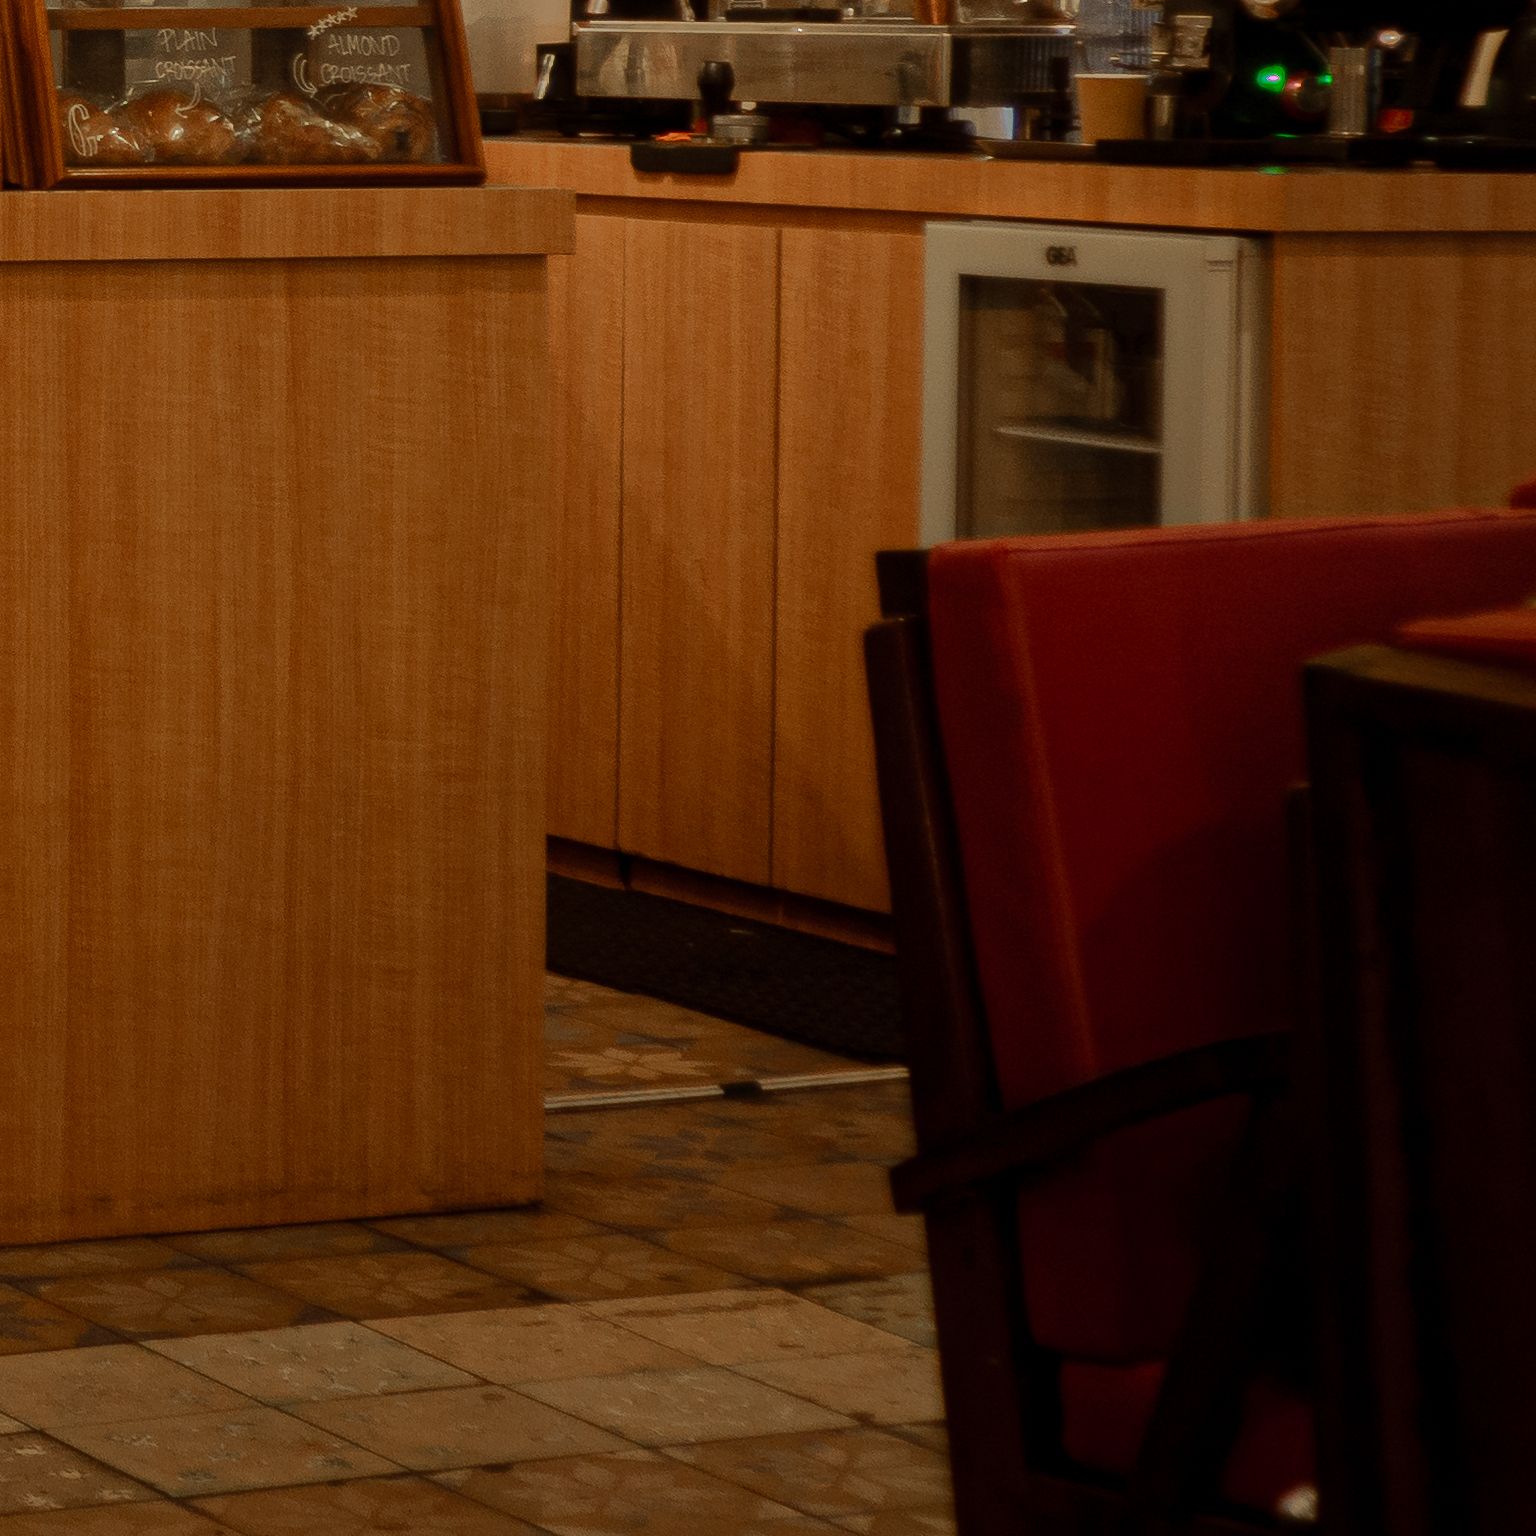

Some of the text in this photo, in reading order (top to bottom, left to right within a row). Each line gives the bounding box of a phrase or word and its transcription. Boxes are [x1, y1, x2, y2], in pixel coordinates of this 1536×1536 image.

[158, 27, 218, 53] PLAIN
[327, 33, 401, 57] ALMOND
[154, 54, 236, 81] CROISSANT
[319, 63, 411, 85] CROISSANT
